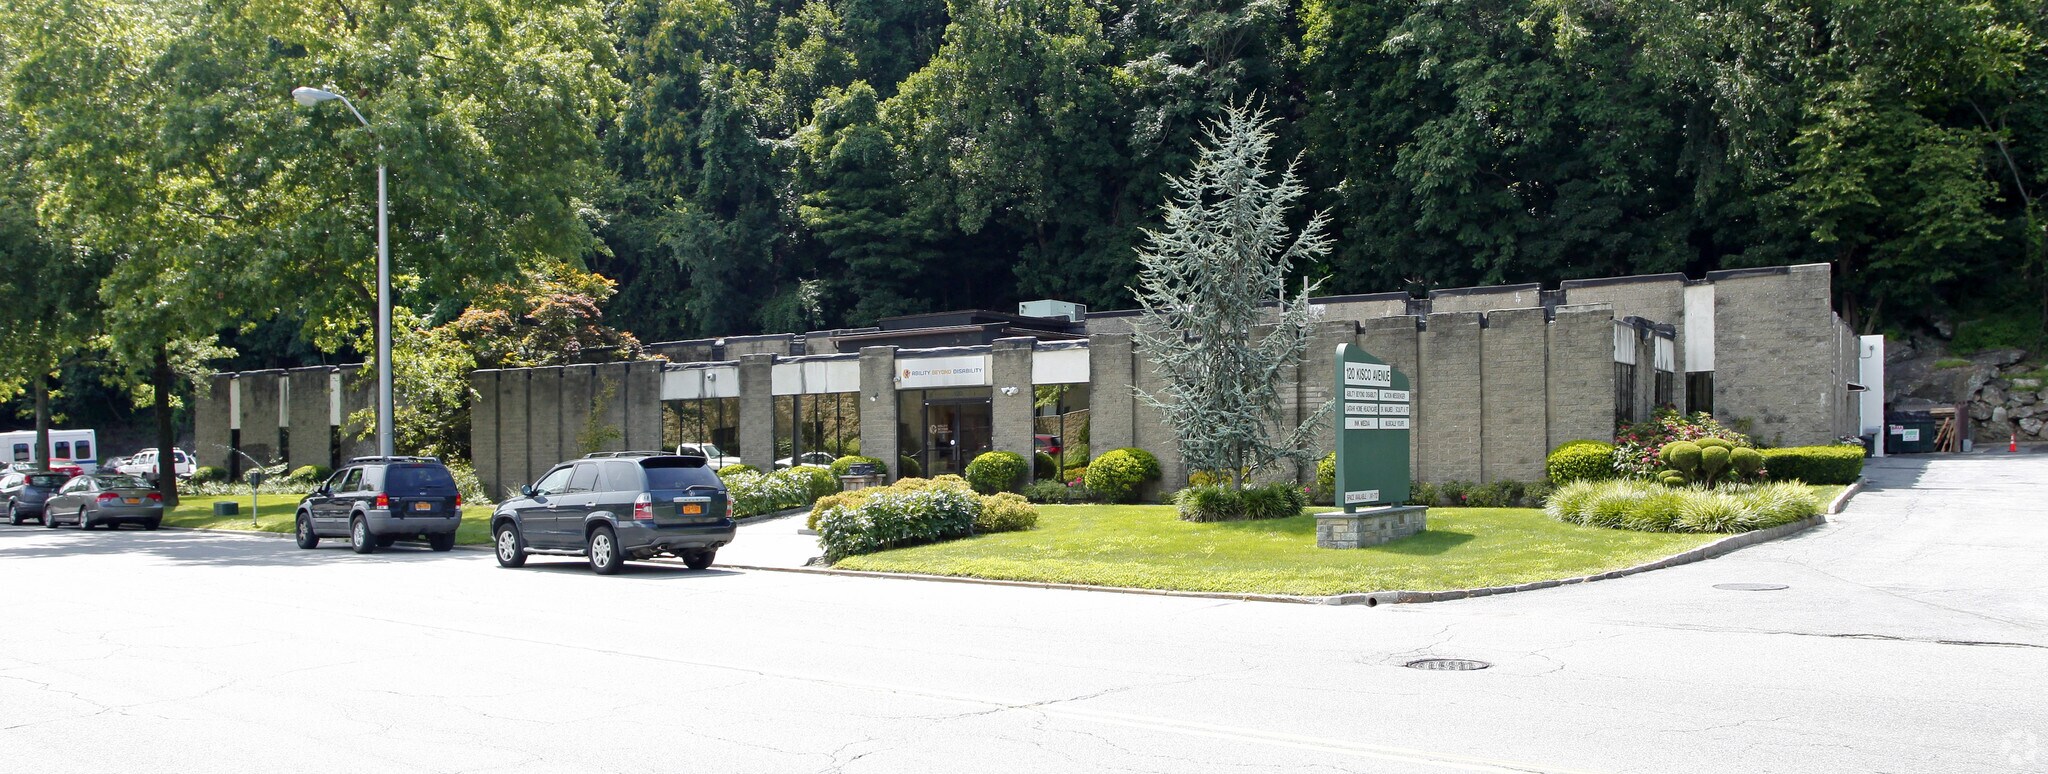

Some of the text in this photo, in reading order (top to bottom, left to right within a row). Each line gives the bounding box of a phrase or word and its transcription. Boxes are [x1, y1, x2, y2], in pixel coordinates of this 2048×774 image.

[1346, 367, 1390, 382] 120 KISCO AVENUE
